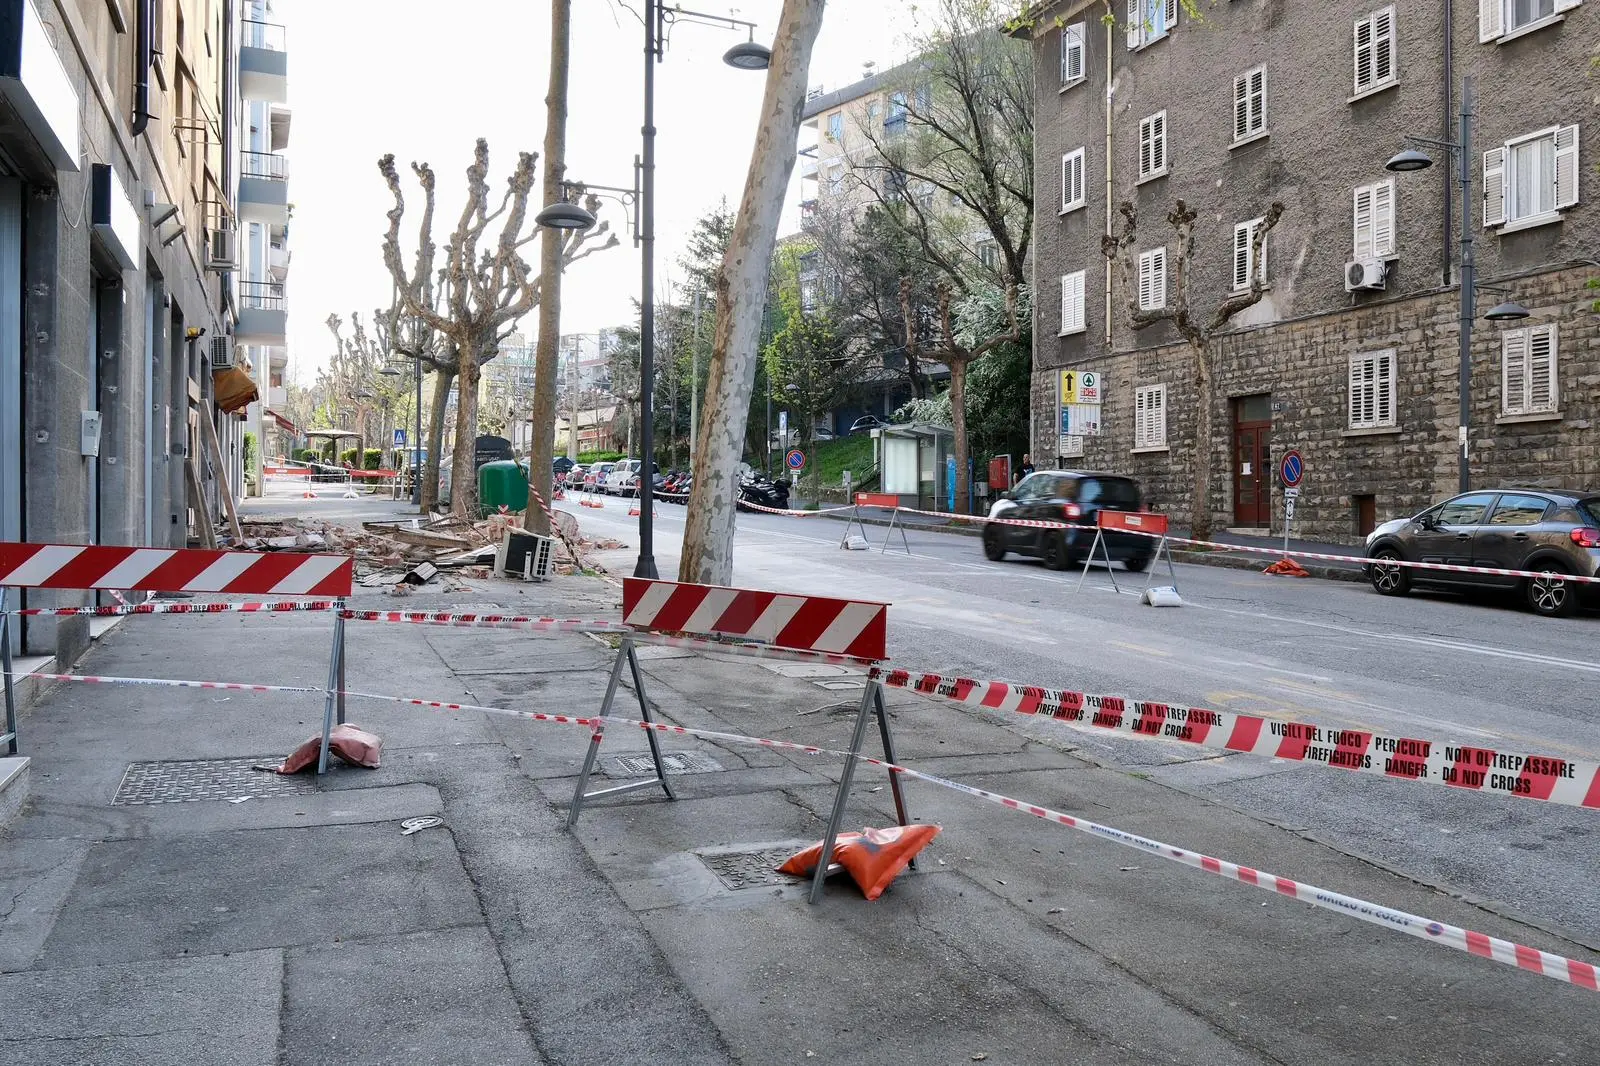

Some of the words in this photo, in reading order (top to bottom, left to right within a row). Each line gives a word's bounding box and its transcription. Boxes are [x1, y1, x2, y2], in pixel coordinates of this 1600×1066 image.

[938, 684, 958, 697] CROSS
[1013, 685, 1037, 697] VIGILI
[1038, 688, 1052, 700] DEL
[1053, 690, 1078, 704] FUOCO
[1086, 695, 1125, 711] PERICOLO
[1134, 702, 1153, 716] NON
[1155, 705, 1222, 726] OLTREPASSARE
[1035, 702, 1084, 721] FIREFIGHTERS
[1092, 712, 1123, 728] DANGER
[1131, 718, 1142, 732] DO
[1145, 721, 1162, 734] NOT
[1165, 723, 1193, 739] CROSS
[1270, 722, 1301, 739] VIGILI
[1305, 727, 1323, 742] DEL
[1327, 730, 1362, 748] FUOCO
[1375, 736, 1430, 758] PERICOLO
[1445, 746, 1471, 765] NON
[1476, 751, 1575, 779] OLTREPASSARE
[1303, 744, 1371, 769] FIREFIGHTERS
[1385, 758, 1428, 778] DANGER
[1442, 767, 1457, 784] DO
[1462, 770, 1485, 787] NOT
[1491, 773, 1532, 794] CROSS
